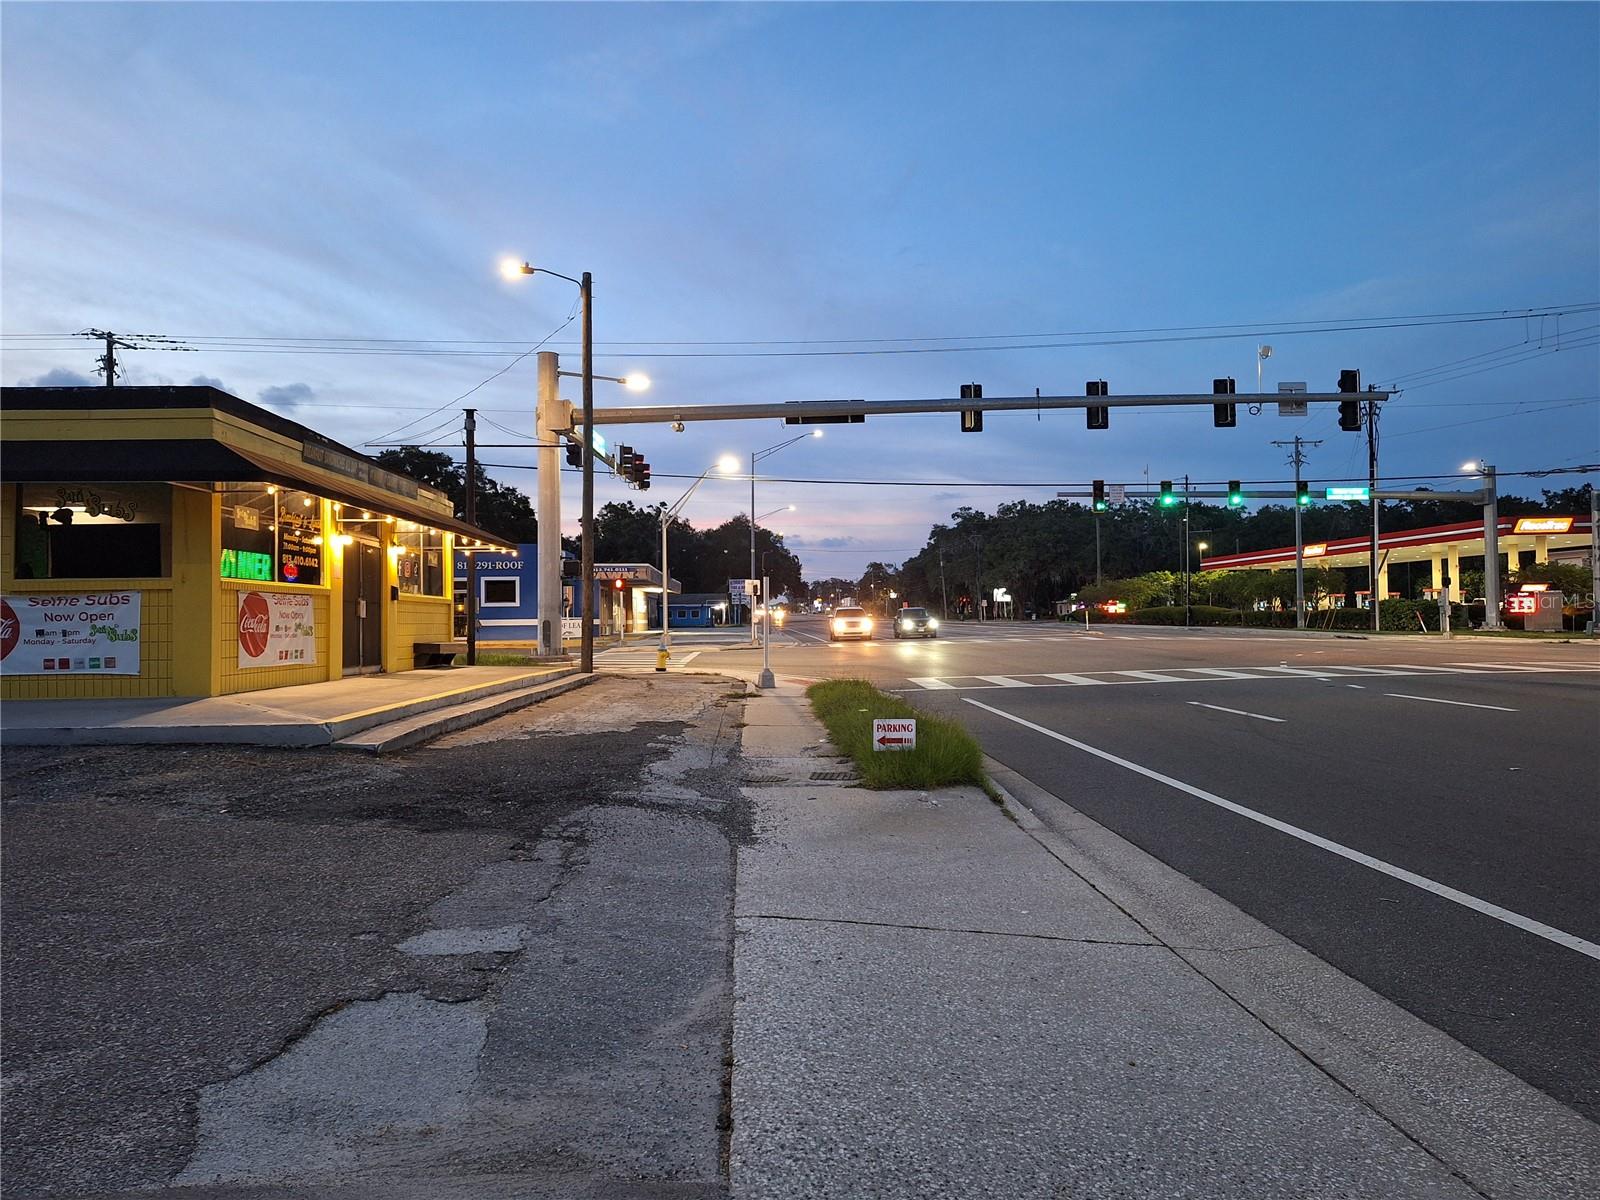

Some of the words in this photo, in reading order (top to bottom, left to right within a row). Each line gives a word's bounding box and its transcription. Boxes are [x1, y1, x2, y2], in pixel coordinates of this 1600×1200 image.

[457, 561, 524, 570] 81-291-ROOF
[28, 597, 80, 606] Selfie
[85, 593, 130, 605] Subs
[44, 612, 75, 622] Now
[79, 611, 114, 623] Open
[62, 637, 96, 645] Saturday
[876, 723, 913, 733] PARKING
